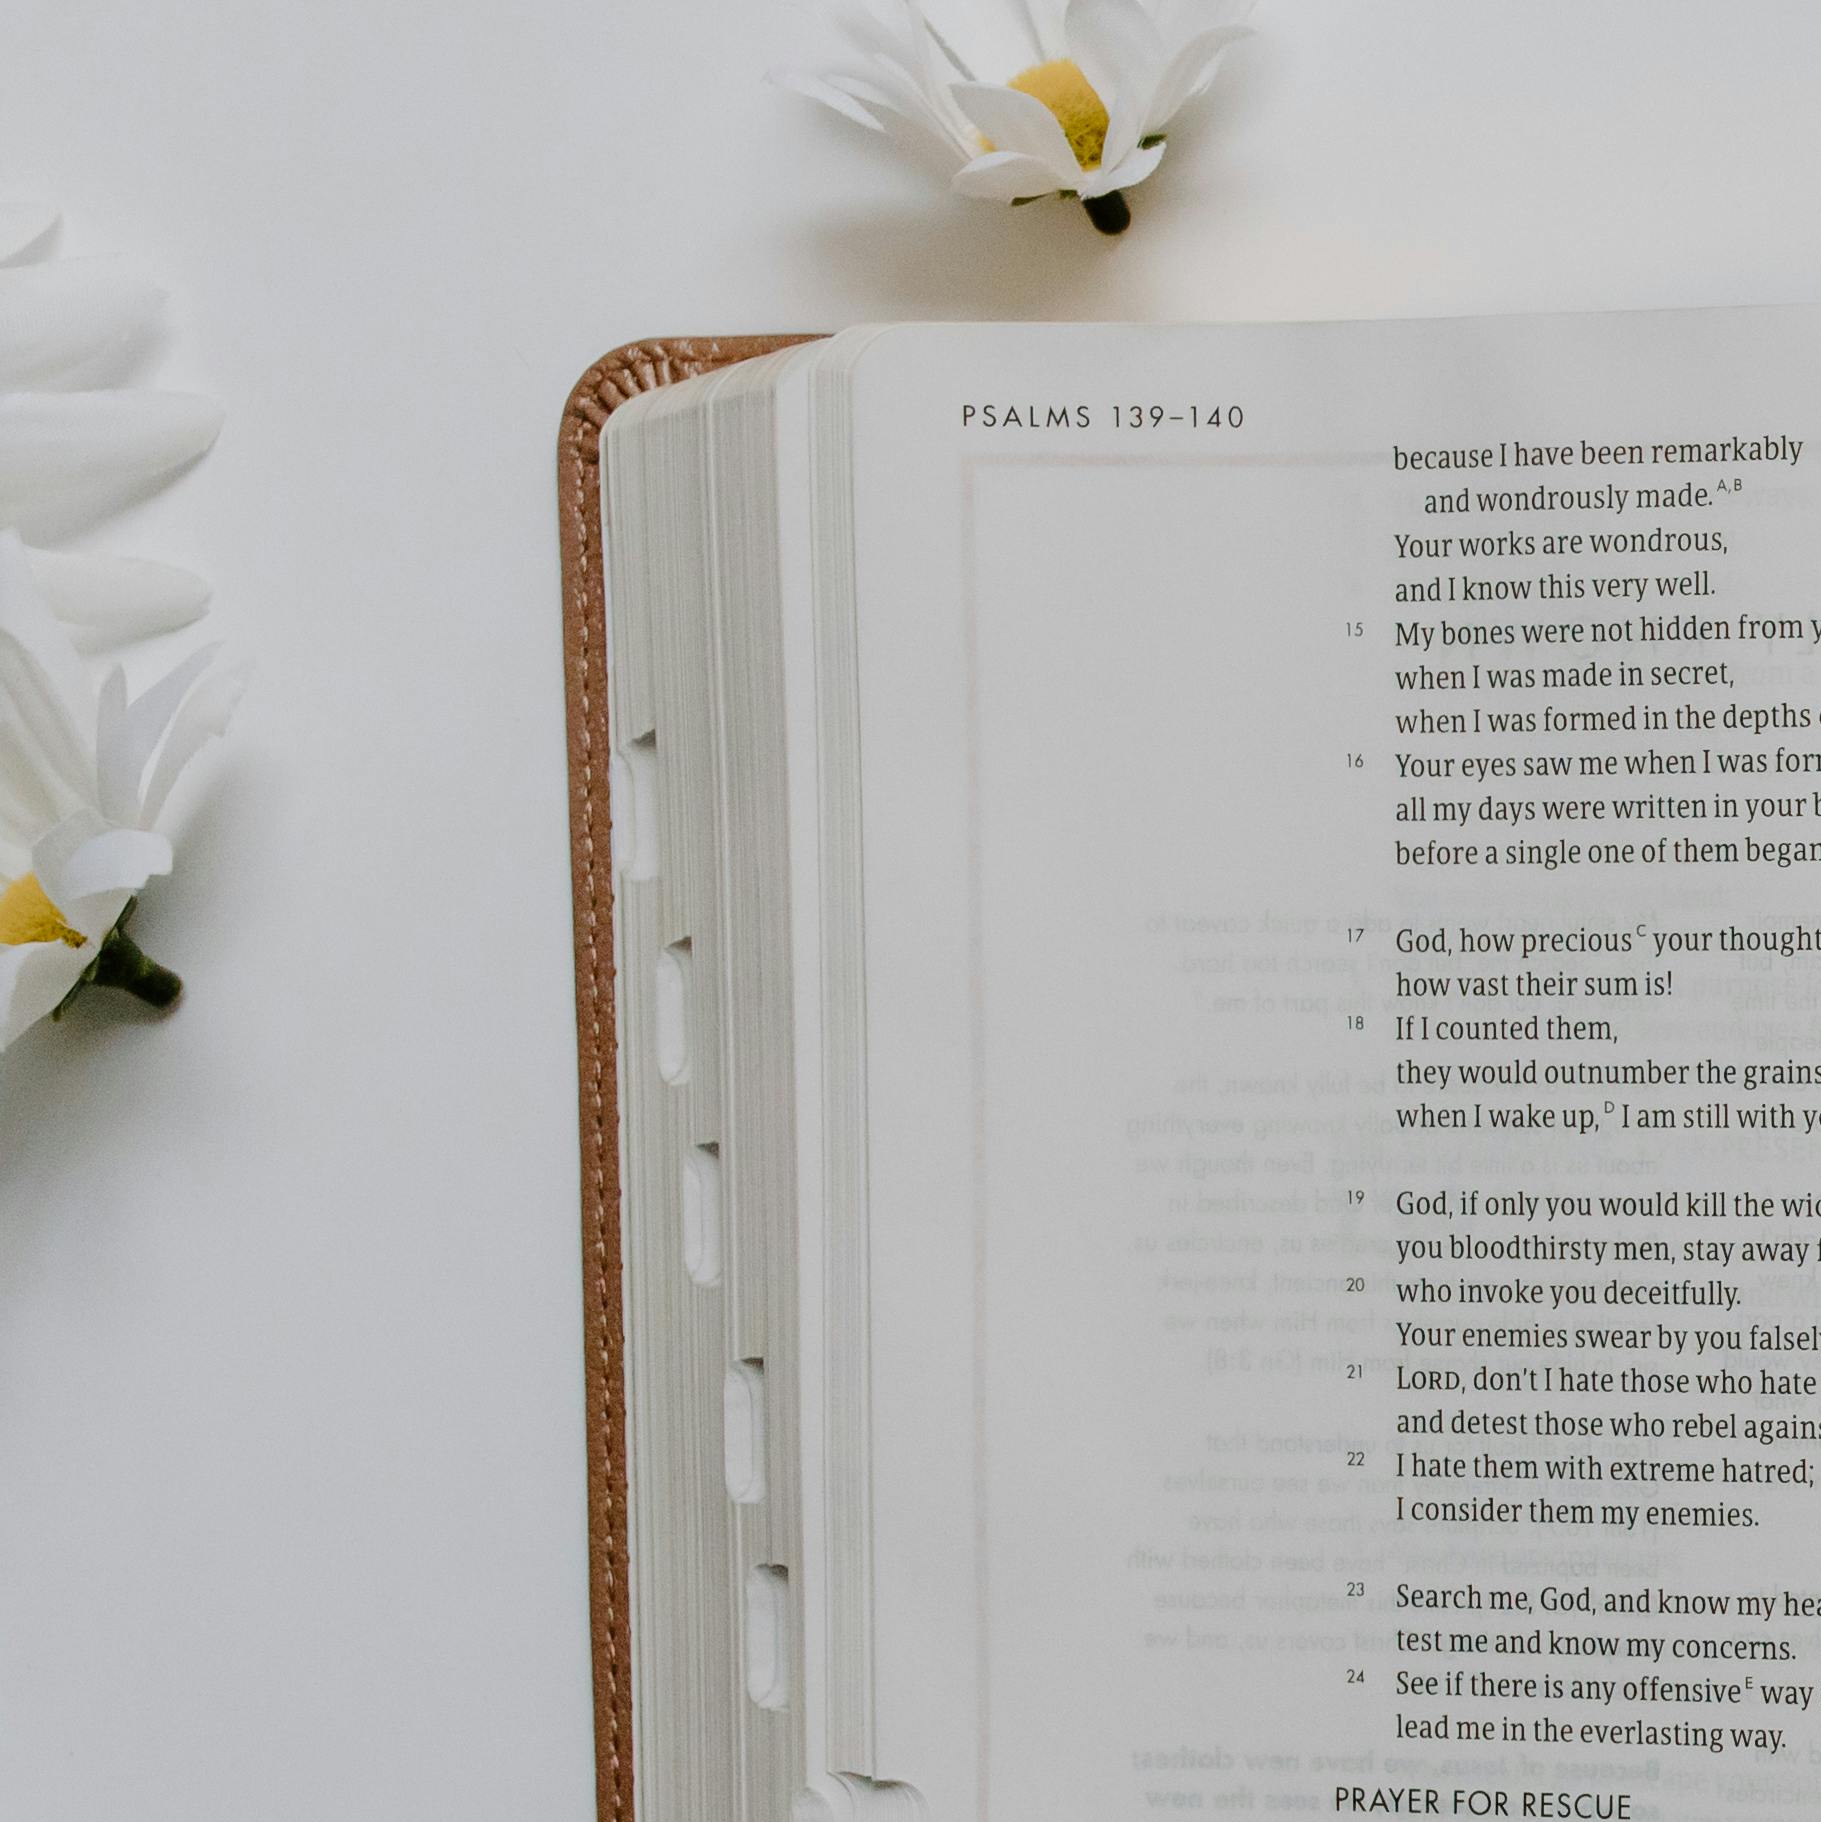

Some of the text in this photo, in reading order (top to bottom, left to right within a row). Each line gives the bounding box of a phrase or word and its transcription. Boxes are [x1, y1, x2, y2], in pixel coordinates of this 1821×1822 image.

[961, 403, 1092, 430] PSALMS
[1391, 433, 1806, 472] because I have been remarkably
[1393, 620, 1437, 653] My
[1439, 618, 1516, 647] bones
[1519, 622, 1586, 645] were
[1589, 618, 1635, 644] not
[1638, 613, 1732, 643] hidden
[1736, 612, 1805, 641] from
[1394, 1014, 1416, 1042] If
[1420, 1015, 1431, 1042] I
[1434, 1014, 1541, 1042] counted
[1545, 1013, 1619, 1046] them,
[1395, 1582, 1484, 1611] Search
[1487, 1589, 1534, 1616] me,
[1539, 1585, 1598, 1618] God,
[1603, 1586, 1652, 1615] and
[1656, 1587, 1732, 1616] know
[1734, 1595, 1778, 1623] my
[1334, 1785, 1632, 1822] PRAYER FOR RESCUE
